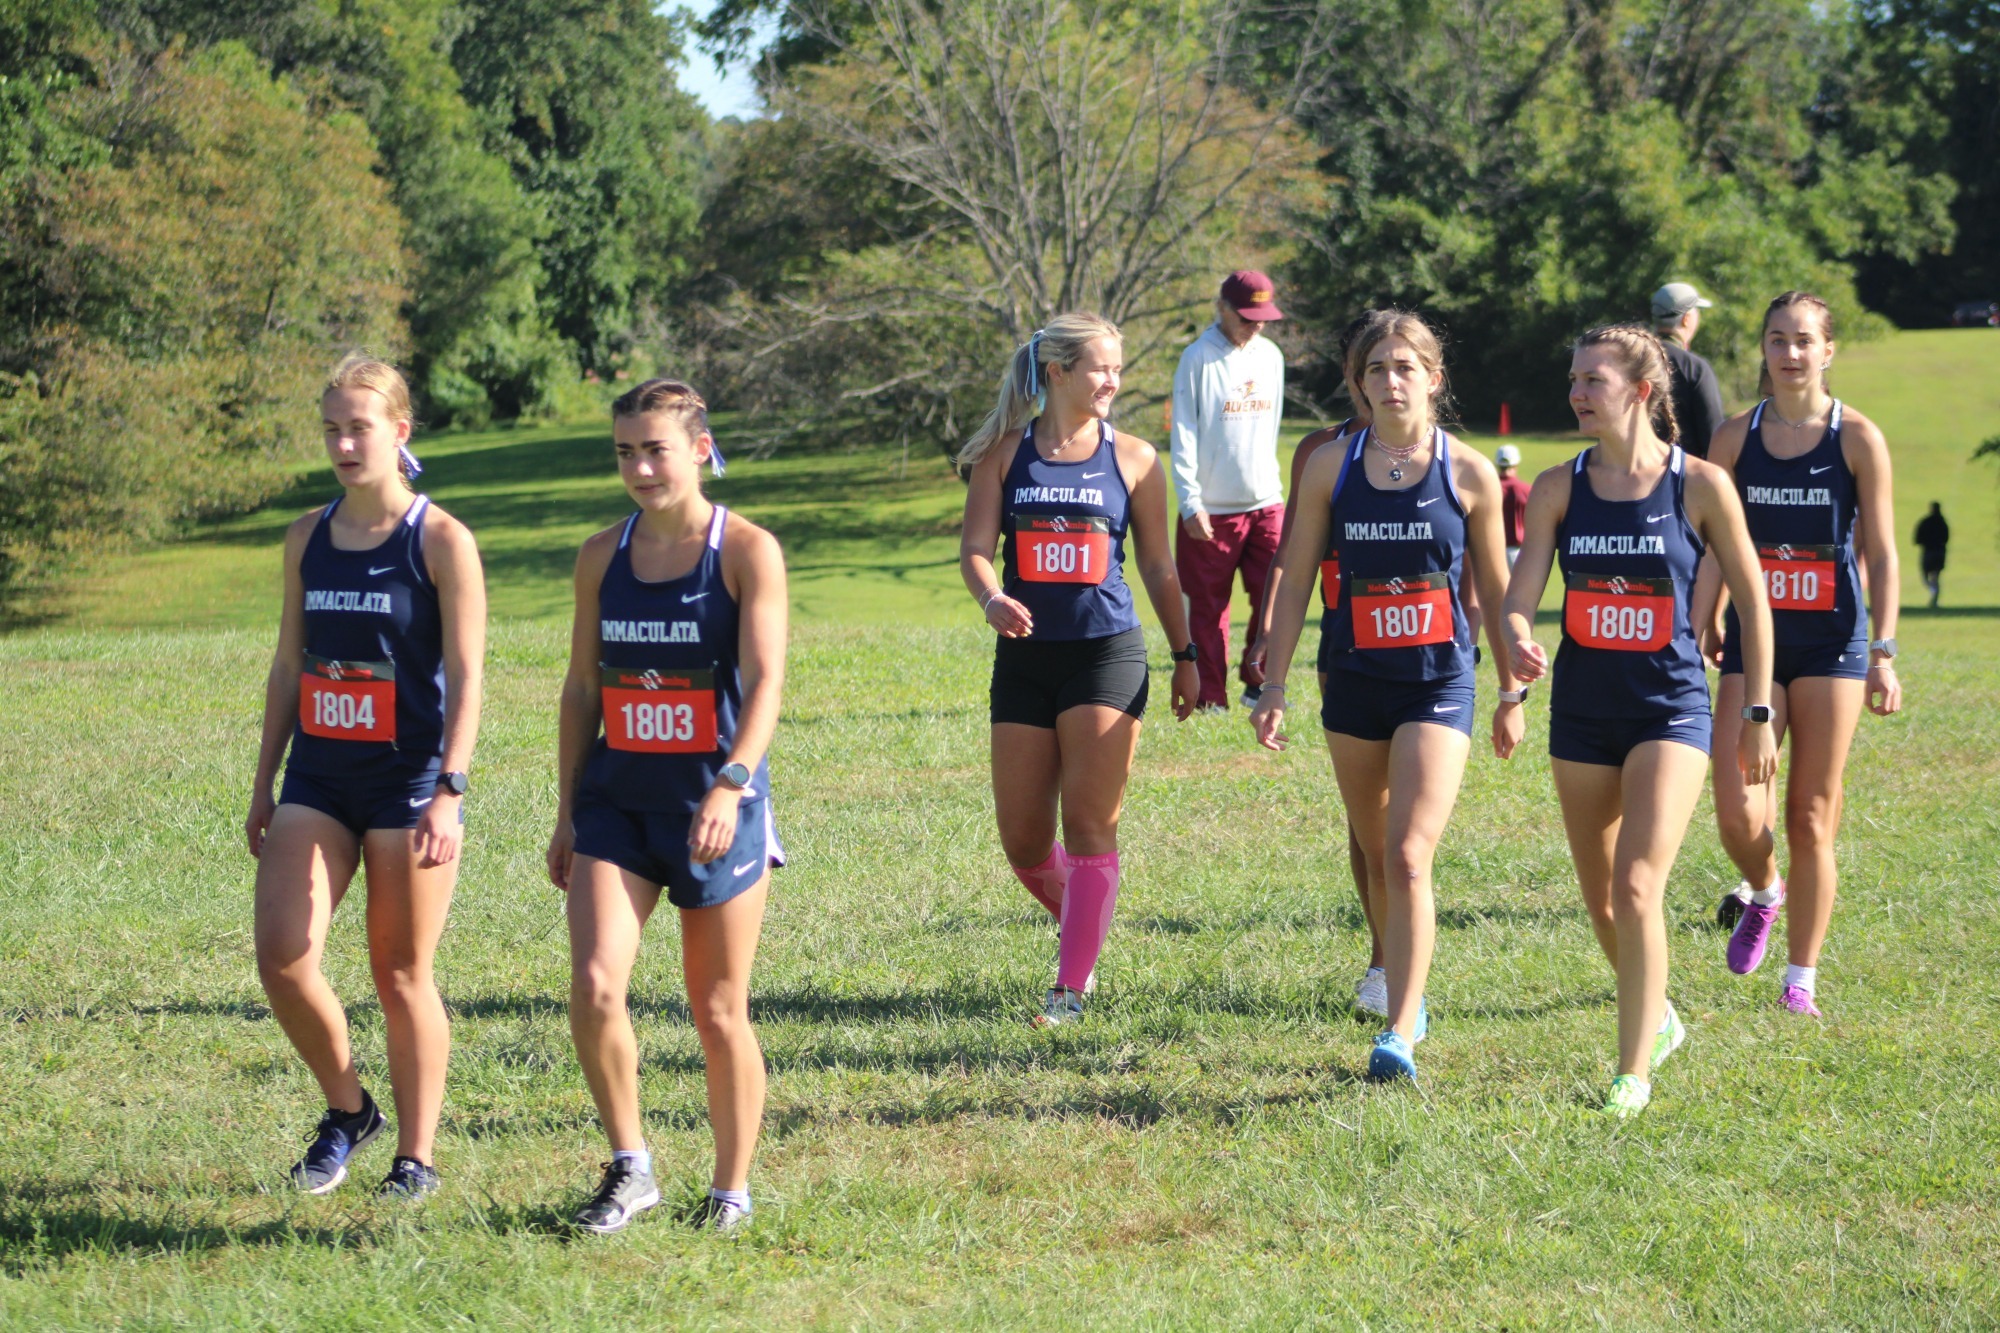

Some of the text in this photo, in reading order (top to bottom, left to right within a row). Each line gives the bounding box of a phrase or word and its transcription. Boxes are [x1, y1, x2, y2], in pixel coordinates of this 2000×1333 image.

[1014, 486, 1104, 507] IMMACULATA
[1746, 485, 1831, 506] IMMACULATA
[1344, 522, 1434, 541] IMMACULATA
[1569, 535, 1666, 555] IMMACULATA
[1032, 542, 1091, 574] 1801
[601, 619, 701, 643] IMMACULATA
[1370, 602, 1434, 638] 1807
[1586, 604, 1655, 641] 1809
[312, 690, 376, 729] 1804
[620, 702, 694, 741] 1803
